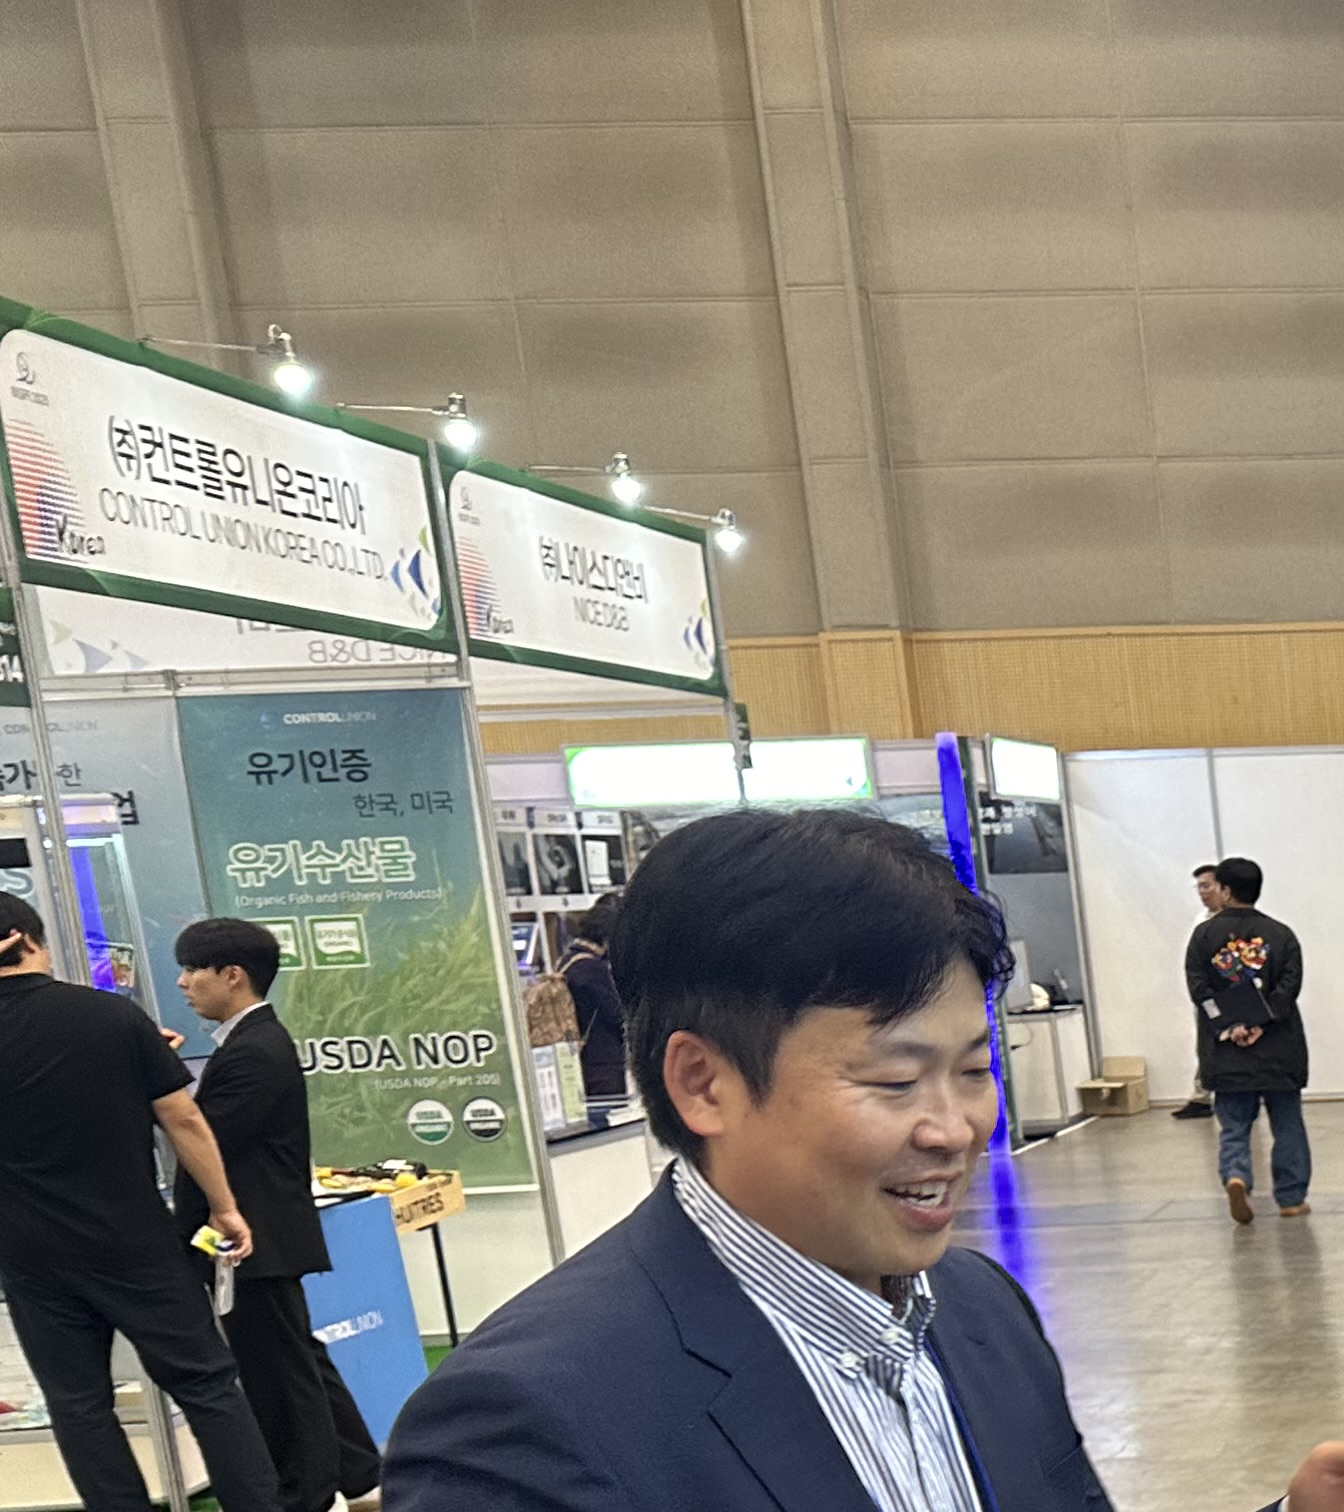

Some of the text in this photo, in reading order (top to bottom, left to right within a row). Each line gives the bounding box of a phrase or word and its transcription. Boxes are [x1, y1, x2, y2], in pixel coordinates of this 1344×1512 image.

[247, 748, 372, 786] 유기인증
[353, 790, 454, 818] 한국, 미국
[226, 836, 416, 888] 유기수산물
[408, 1030, 498, 1070] NOP
